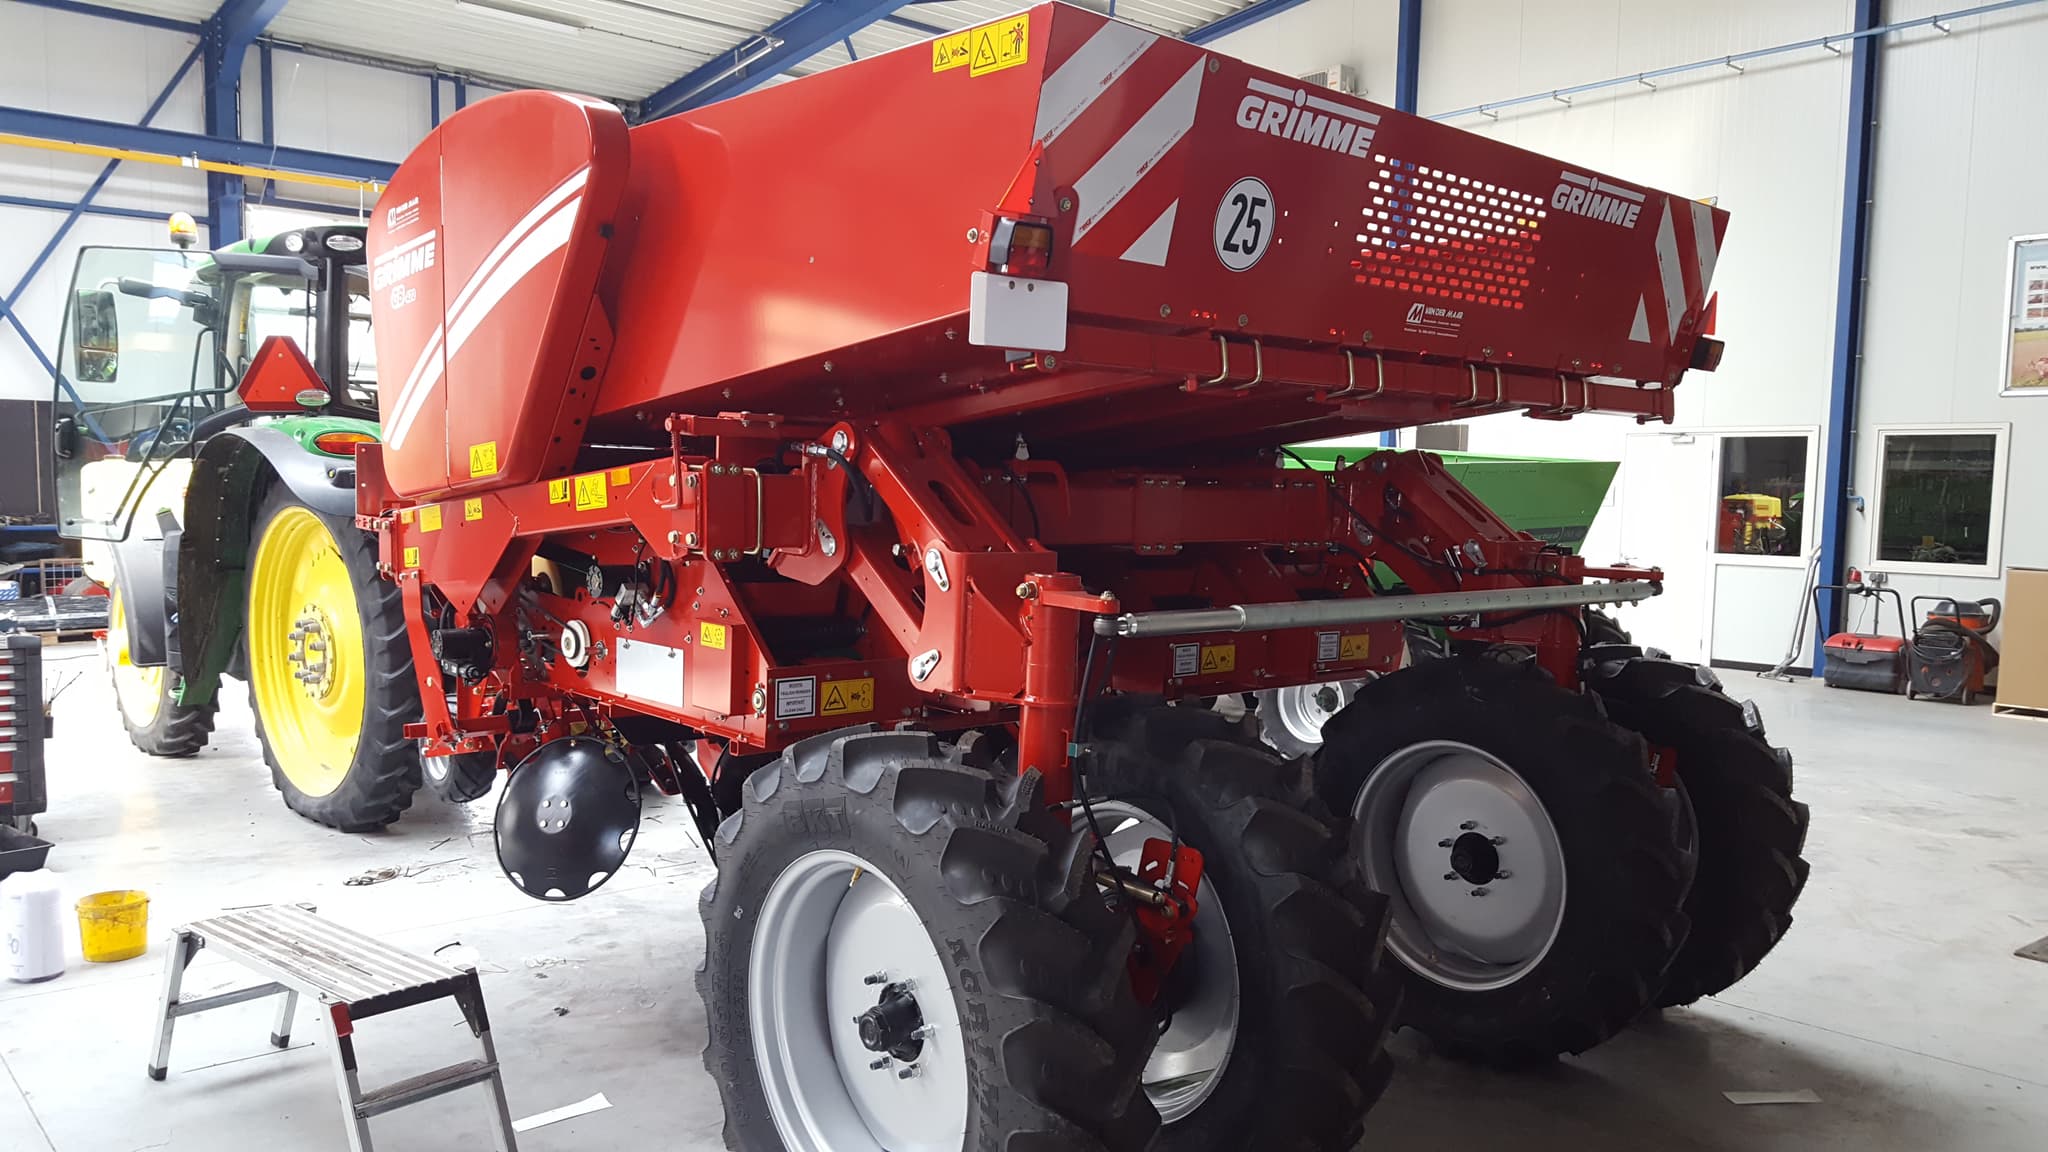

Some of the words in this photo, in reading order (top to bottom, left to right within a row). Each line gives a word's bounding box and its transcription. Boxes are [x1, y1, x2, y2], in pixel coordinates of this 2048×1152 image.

[1237, 86, 1376, 159] GRIMME
[1223, 193, 1267, 255] 25
[1551, 176, 1643, 229] GRIMME
[373, 241, 435, 292] GRIMME
